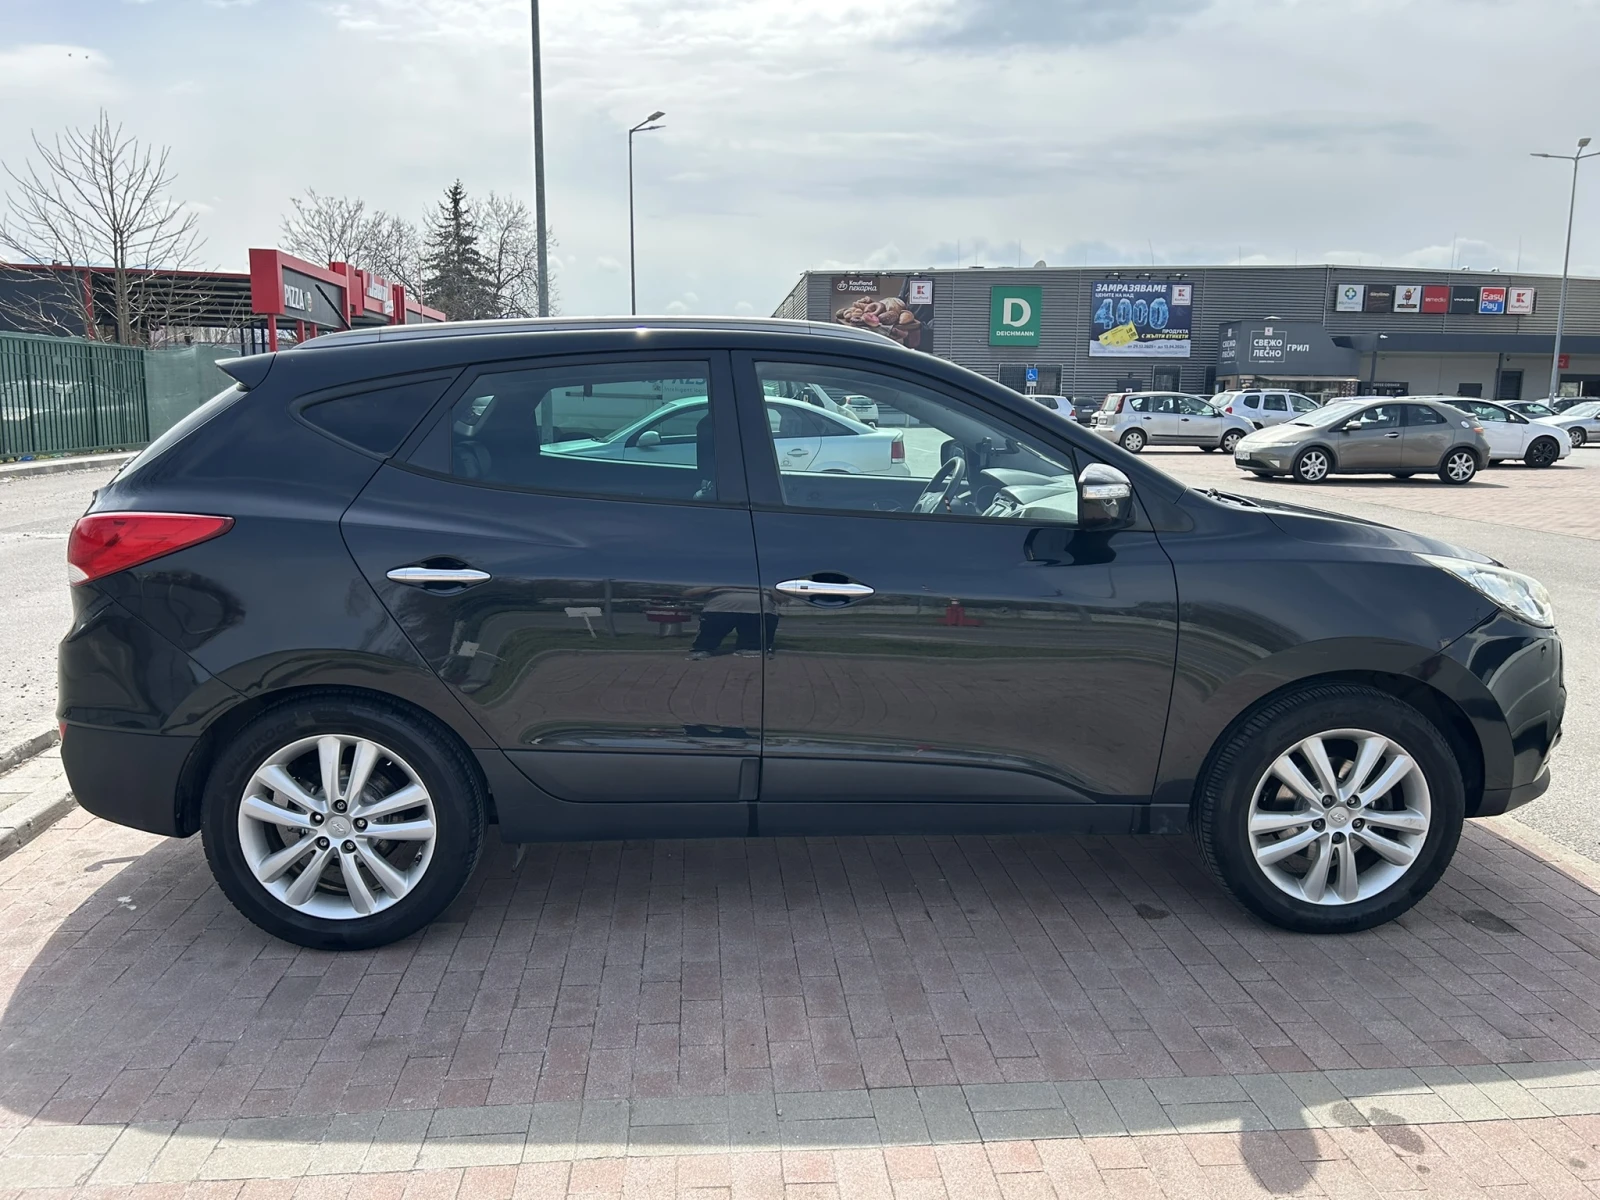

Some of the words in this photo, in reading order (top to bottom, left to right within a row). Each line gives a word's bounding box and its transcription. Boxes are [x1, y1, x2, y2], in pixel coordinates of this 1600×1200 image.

[1095, 284, 1168, 292] ЗАМРАЗЯВАМЕ
[284, 284, 305, 310] PIZZA
[1482, 292, 1503, 301] Easy
[1481, 301, 1498, 311] Pay
[1094, 298, 1169, 329] 4000
[1253, 339, 1283, 347] СВЕЖО
[1286, 344, 1310, 352] ГРИЛ
[1253, 349, 1282, 357] ЛЕСНО
